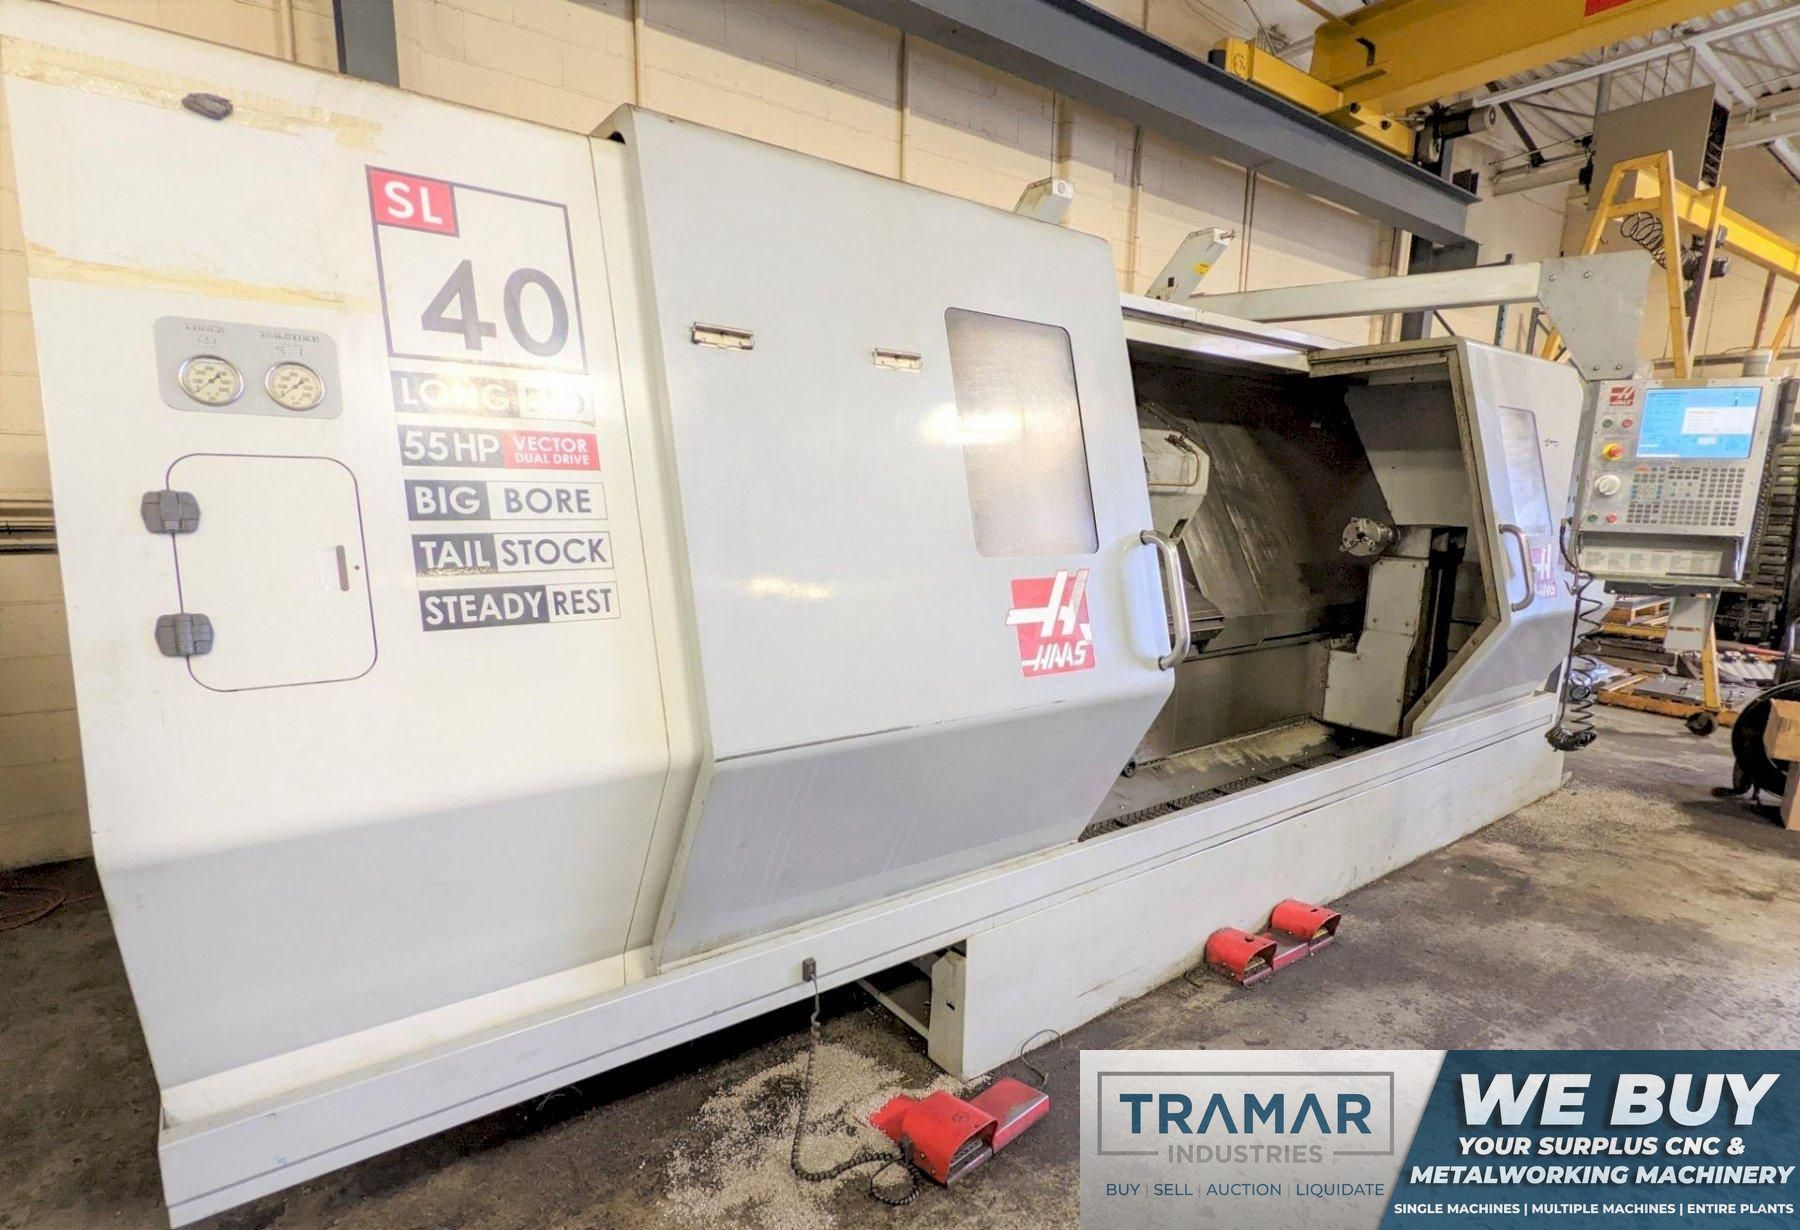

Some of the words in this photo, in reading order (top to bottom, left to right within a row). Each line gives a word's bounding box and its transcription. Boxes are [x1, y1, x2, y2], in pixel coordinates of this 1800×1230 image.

[384, 181, 443, 225] SL
[420, 259, 570, 358] 40
[401, 377, 510, 411] LOG
[513, 434, 588, 453] VECTOR
[515, 452, 550, 465] DUAL
[553, 454, 590, 466] DRIVE
[414, 486, 481, 515] BIG
[503, 488, 592, 514] BORE
[420, 540, 491, 568] TAIL
[501, 538, 608, 567] STOCK
[425, 591, 542, 625] STEADY
[552, 588, 613, 616] REST
[1021, 640, 1090, 671] HAAS
